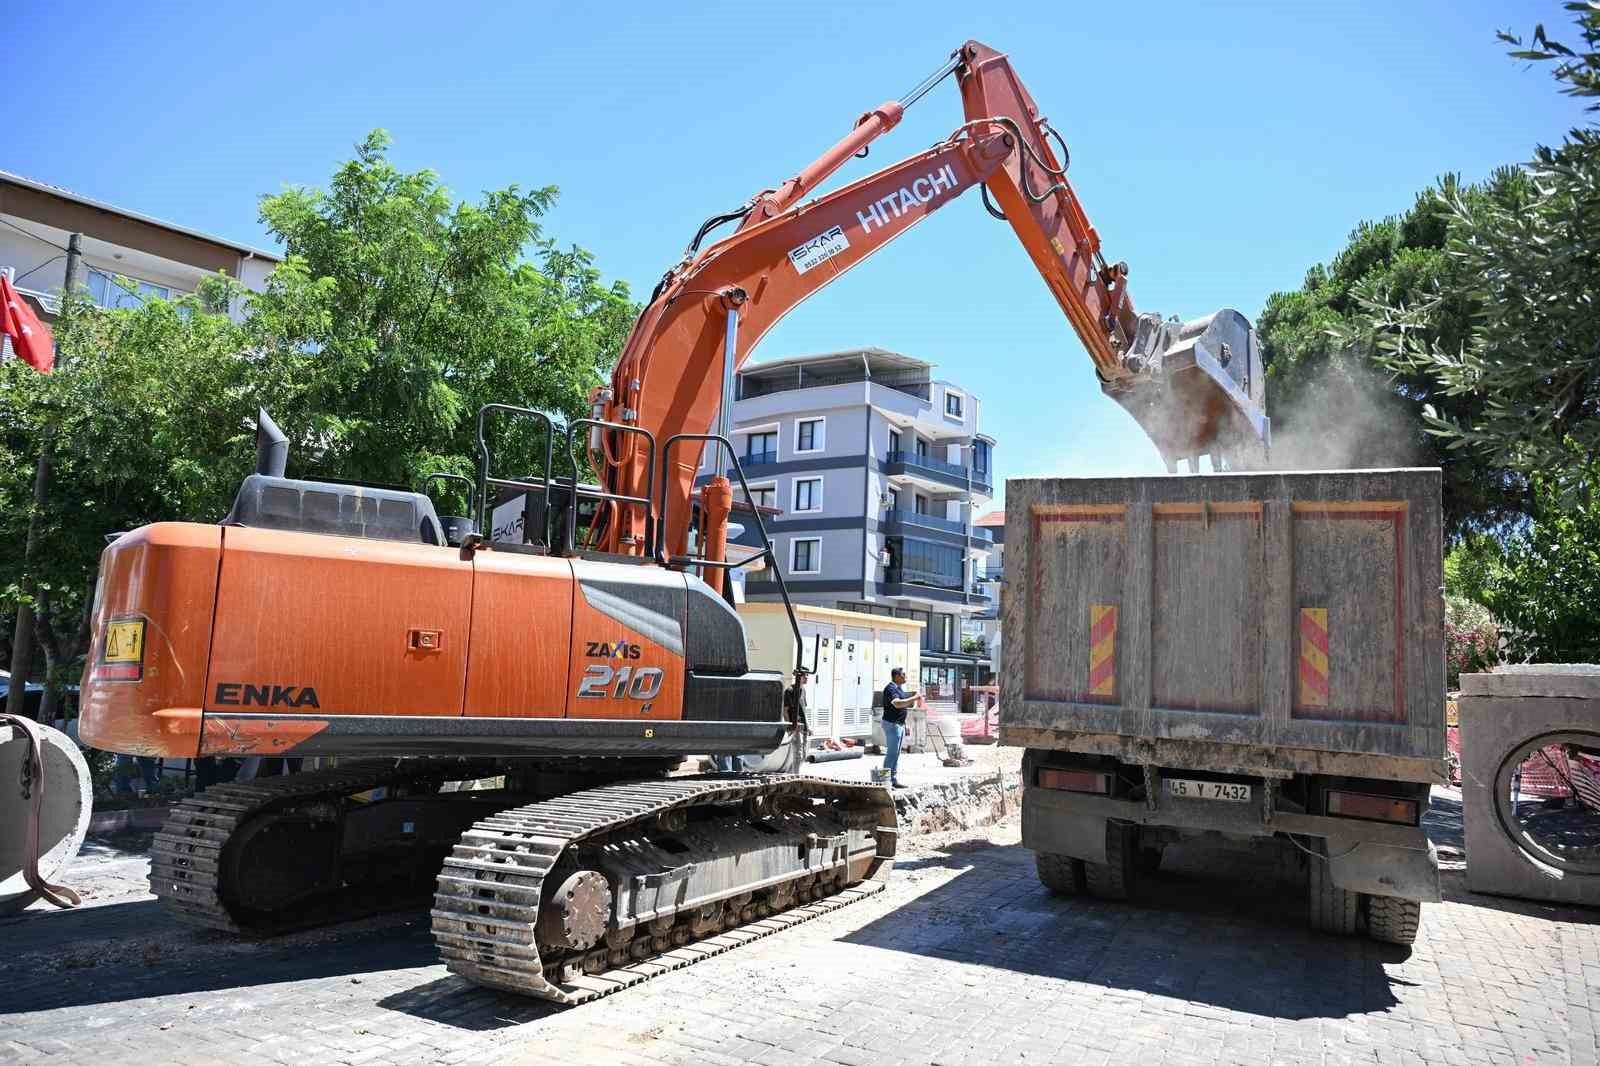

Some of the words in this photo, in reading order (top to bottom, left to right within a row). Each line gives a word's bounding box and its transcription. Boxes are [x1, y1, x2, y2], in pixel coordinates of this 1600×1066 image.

[856, 164, 958, 234] HITACHI
[493, 518, 523, 541] SKAR
[586, 640, 640, 660] ZAXIS
[577, 665, 663, 700] 210
[215, 683, 320, 708] ENKA
[1172, 781, 1186, 795] 45
[1197, 783, 1204, 797] Y
[1214, 784, 1247, 800] 7432
